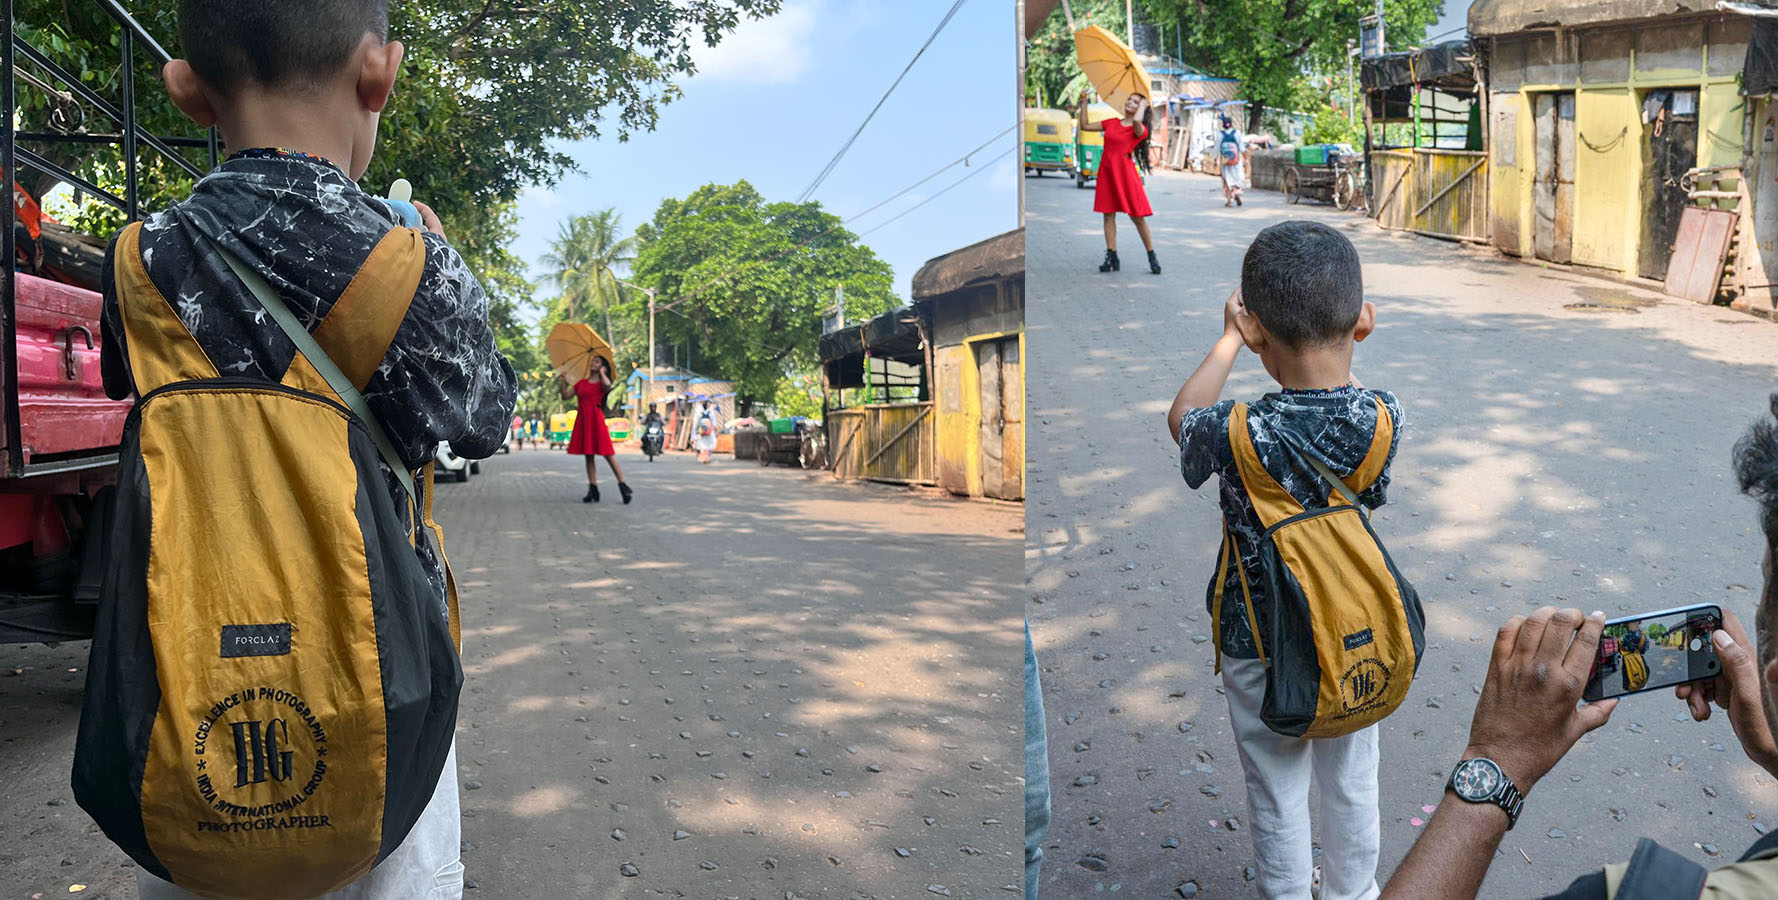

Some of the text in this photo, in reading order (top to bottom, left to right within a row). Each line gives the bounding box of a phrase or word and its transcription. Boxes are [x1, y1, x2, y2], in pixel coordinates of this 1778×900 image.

[235, 636, 280, 646] FORCLAZ
[195, 687, 327, 755] EXCELLENCE IN PHOTOGRAPHY
[229, 717, 294, 789] IIG
[196, 773, 219, 804] INDIA
[303, 760, 328, 796] GROUP
[197, 815, 332, 833] PHOTOGRAPHER
